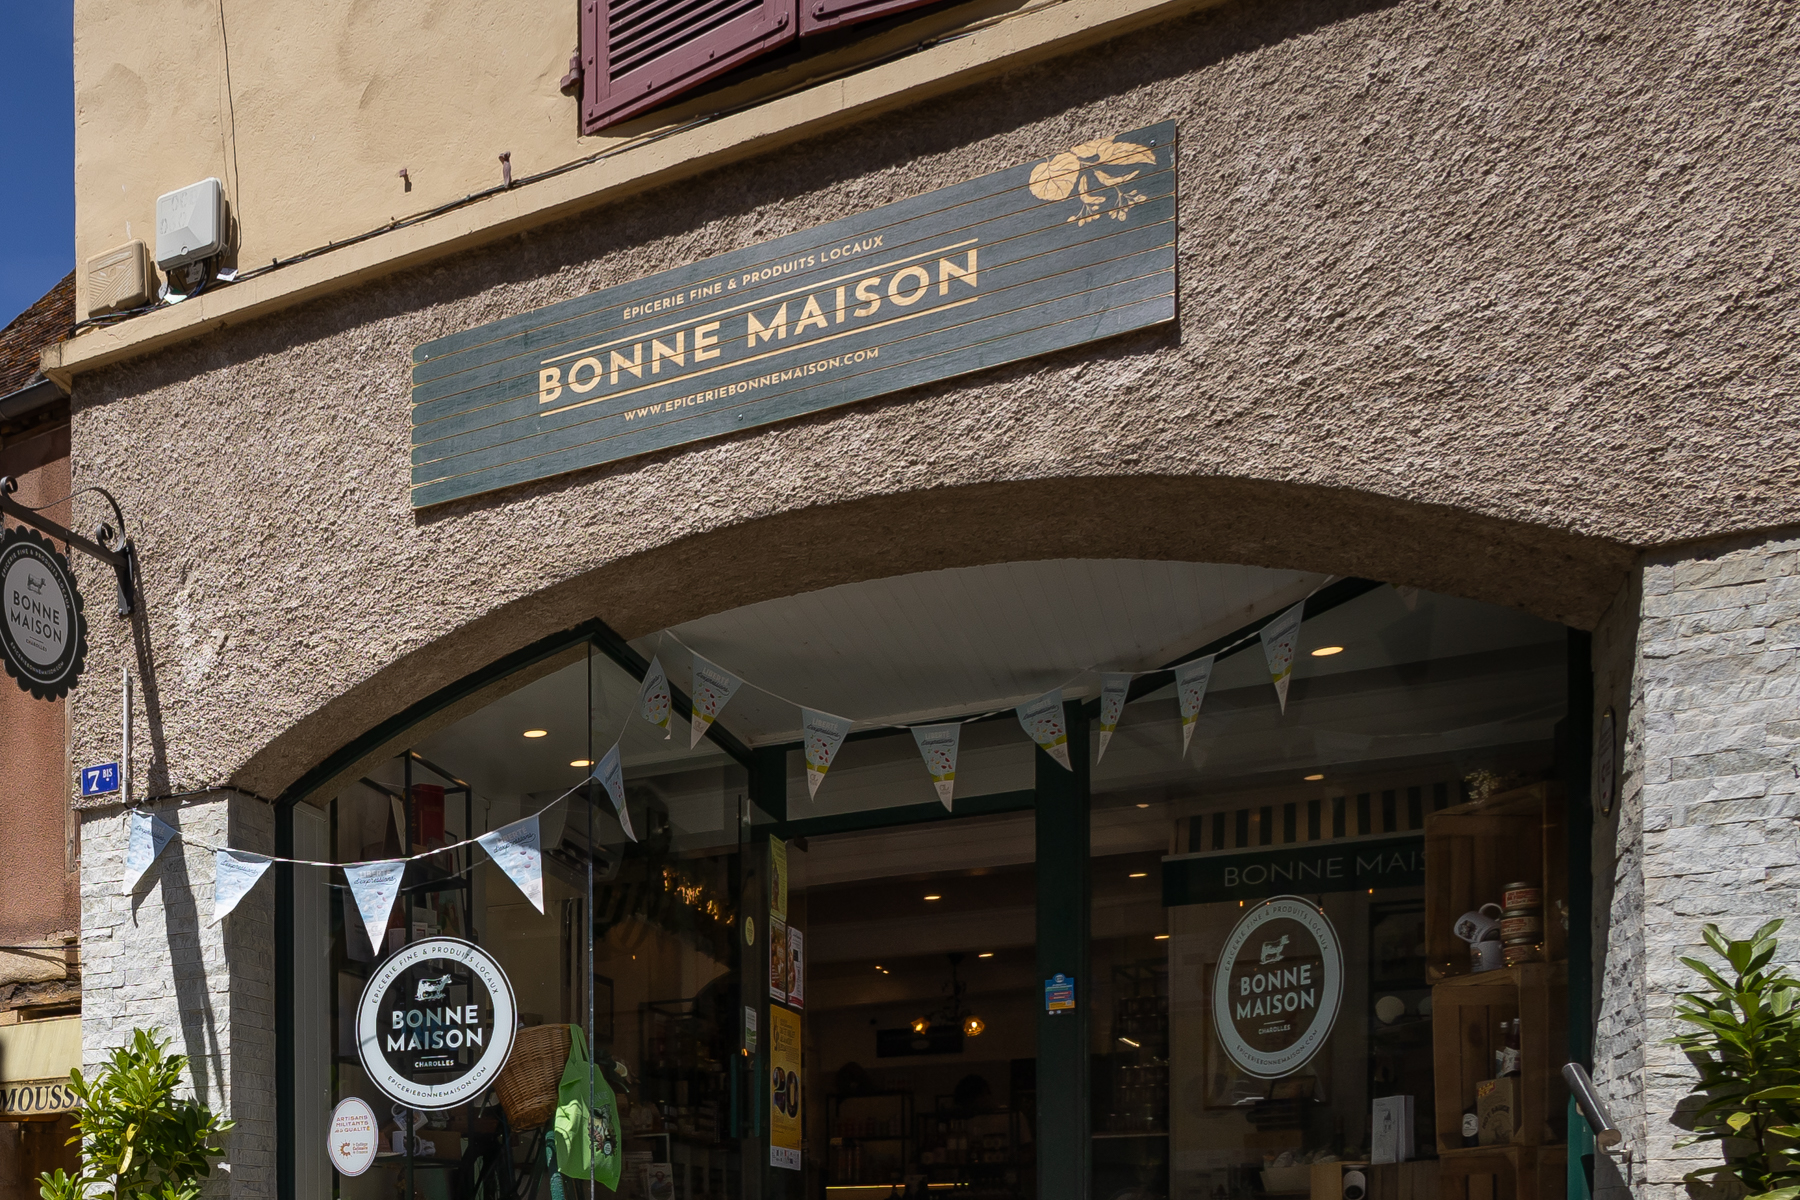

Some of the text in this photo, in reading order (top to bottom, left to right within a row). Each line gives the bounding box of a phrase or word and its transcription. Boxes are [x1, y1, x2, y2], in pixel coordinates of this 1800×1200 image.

[623, 235, 884, 320] ÉPICERIE FINE & PRODUITS LOCAUX
[539, 248, 978, 404] BONNE MAISON
[623, 347, 880, 421] WWW.EPICERIEBONNEMAISON.COM
[13, 590, 60, 625] BONNE
[10, 607, 62, 645] MAISON
[87, 768, 113, 792] 7 BIS
[1224, 856, 1344, 888] BONNE
[1272, 906, 1308, 920] PRODUITS
[1309, 917, 1328, 951] LOCAUX
[399, 951, 419, 967] FINE
[431, 946, 475, 963] PRODUITS
[475, 961, 499, 995] LOCAUX
[1240, 964, 1312, 996] BONNE
[392, 1004, 479, 1029] BONNE
[1236, 988, 1315, 1020] MAISON
[386, 1027, 483, 1052] MAISON
[1258, 1024, 1291, 1035] CHAROLLES
[414, 1059, 455, 1068] CHAROLLES
[387, 1065, 487, 1098] EPICERIEBONNEMAISON.COM
[336, 1114, 368, 1122] ARTISANS
